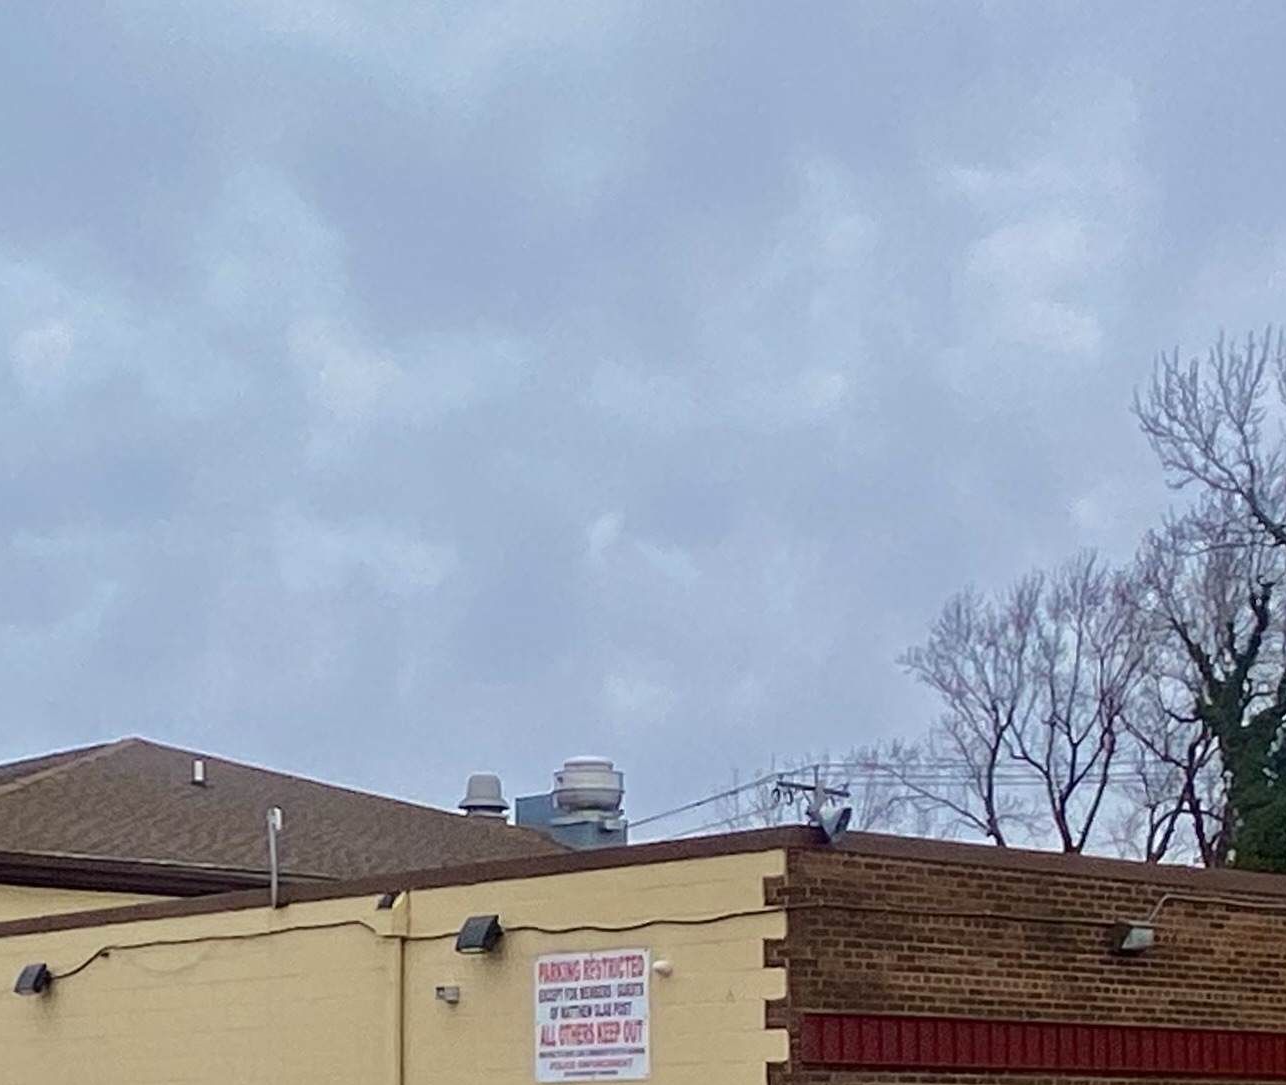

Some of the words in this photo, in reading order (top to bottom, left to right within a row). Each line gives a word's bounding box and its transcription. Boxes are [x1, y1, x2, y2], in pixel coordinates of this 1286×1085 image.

[539, 959, 580, 983] PARKING
[583, 955, 644, 981] RESTRICTED
[541, 1024, 556, 1046] ALL
[559, 1022, 595, 1045] OTHERS
[597, 1021, 620, 1044] KEEP
[624, 1020, 643, 1043] OUT
